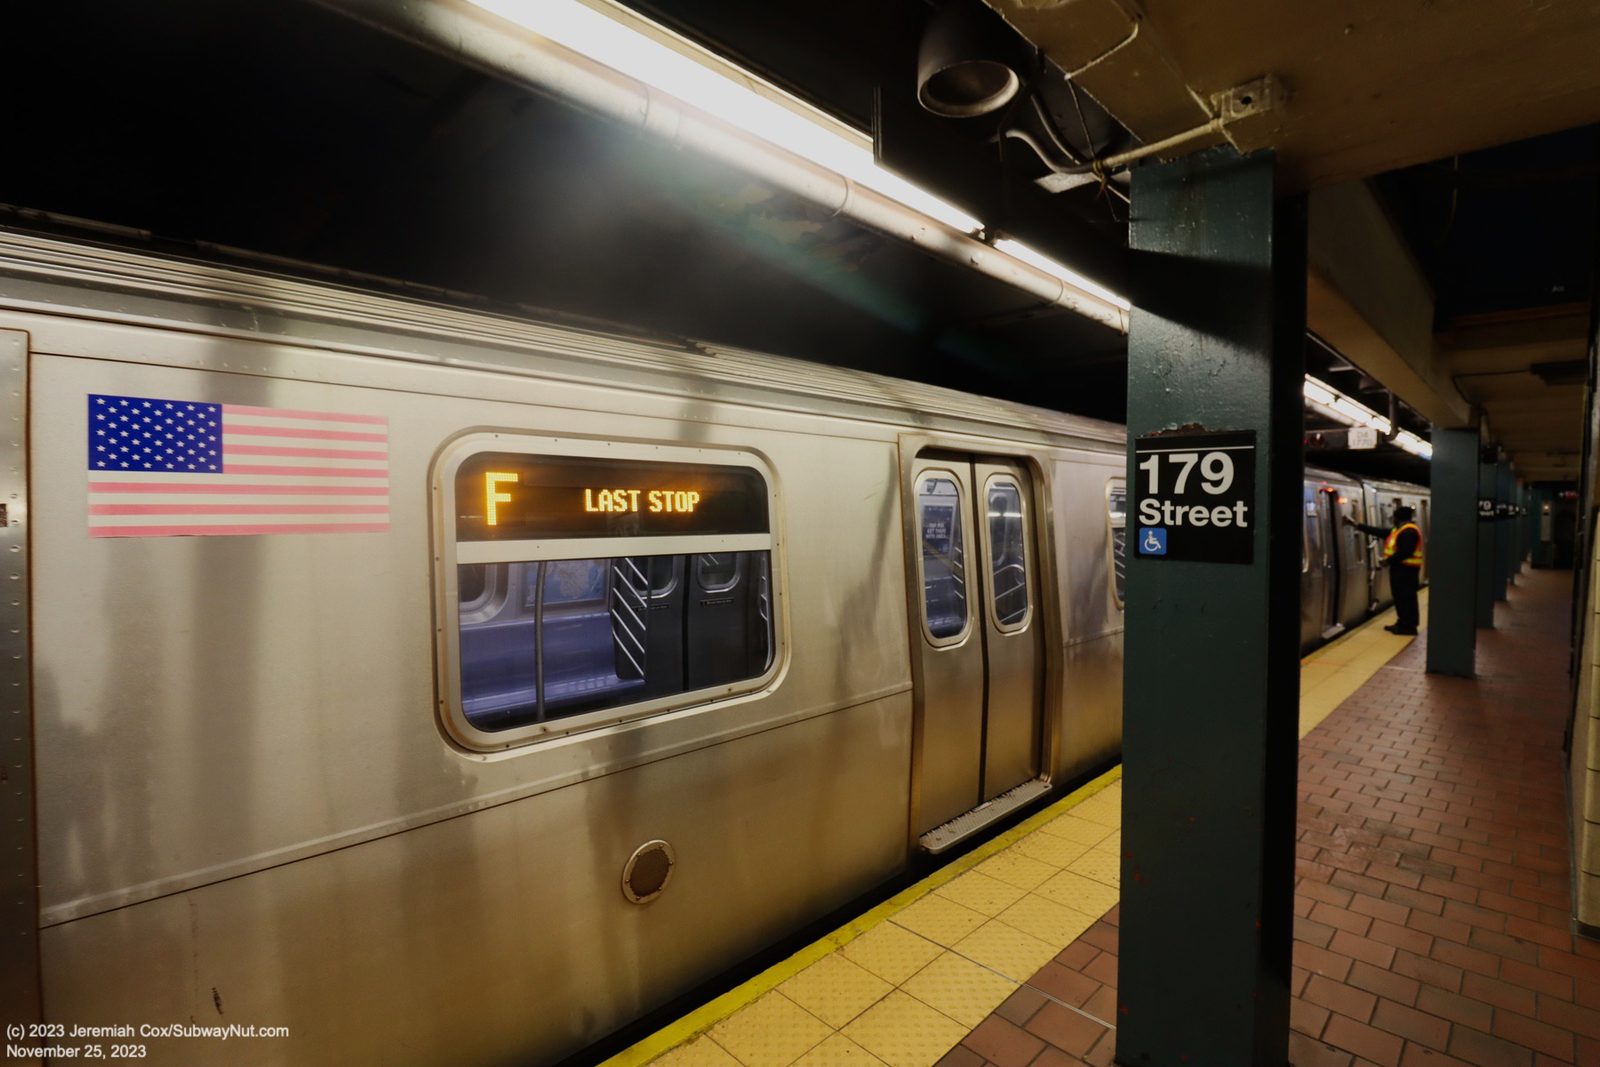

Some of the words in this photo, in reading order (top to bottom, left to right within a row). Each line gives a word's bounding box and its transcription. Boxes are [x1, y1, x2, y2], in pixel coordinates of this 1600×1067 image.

[1139, 451, 1235, 495] 179
[485, 471, 519, 526] F
[585, 488, 641, 512] LAST
[649, 491, 700, 513] STOP
[1138, 498, 1249, 528] Street
